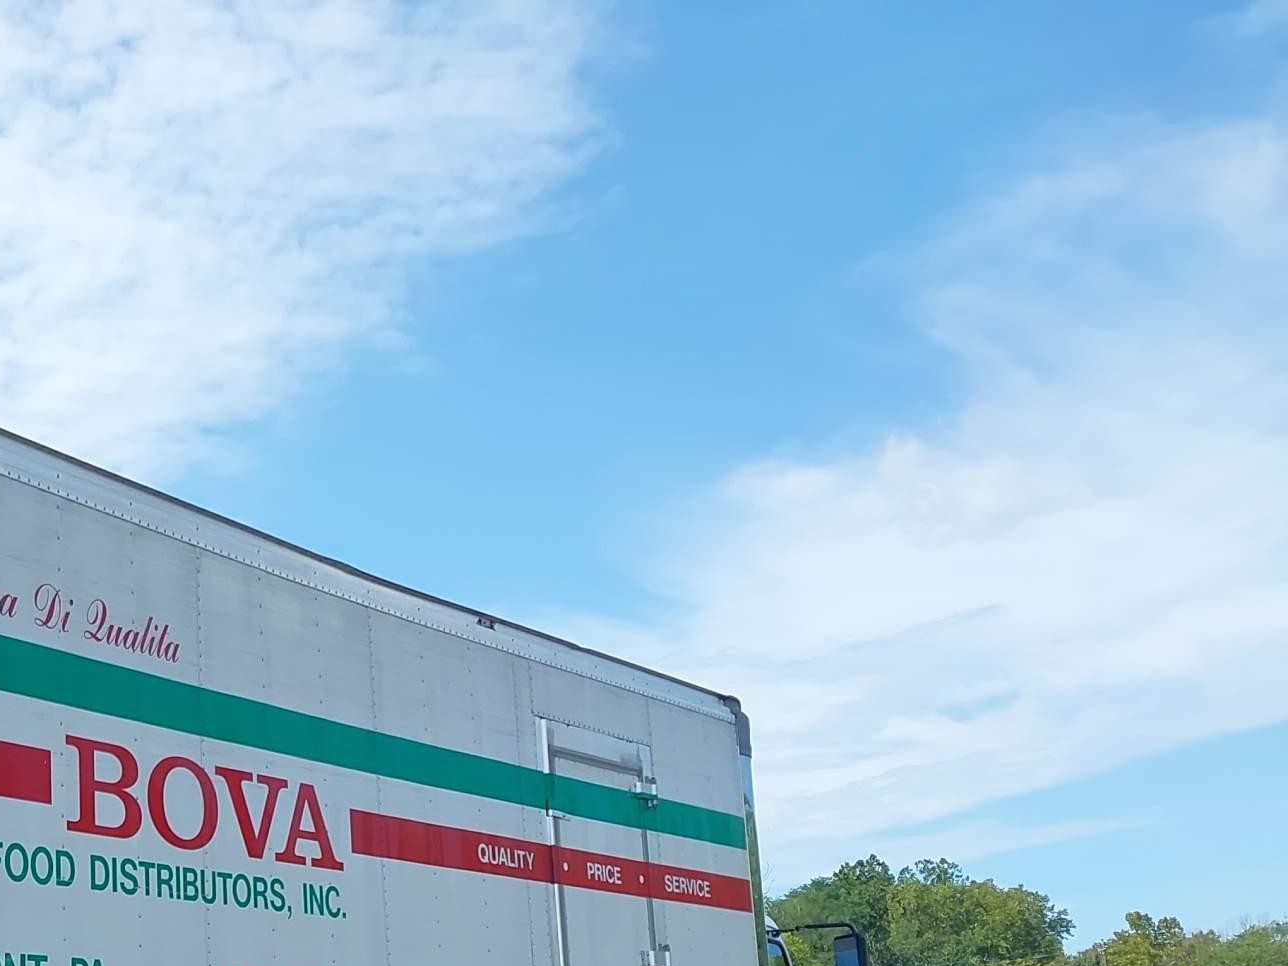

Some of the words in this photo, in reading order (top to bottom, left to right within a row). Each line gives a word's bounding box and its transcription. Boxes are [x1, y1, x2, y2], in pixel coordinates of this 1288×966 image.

[34, 583, 74, 633] Di
[84, 599, 180, 663] Qualita
[65, 734, 345, 872] BOVA
[90, 854, 294, 919] DISTRIBUTORS,
[302, 882, 347, 919] INC.
[477, 843, 535, 870] QUALITY
[586, 862, 622, 885] PRICE
[664, 874, 712, 898] SERVICE
